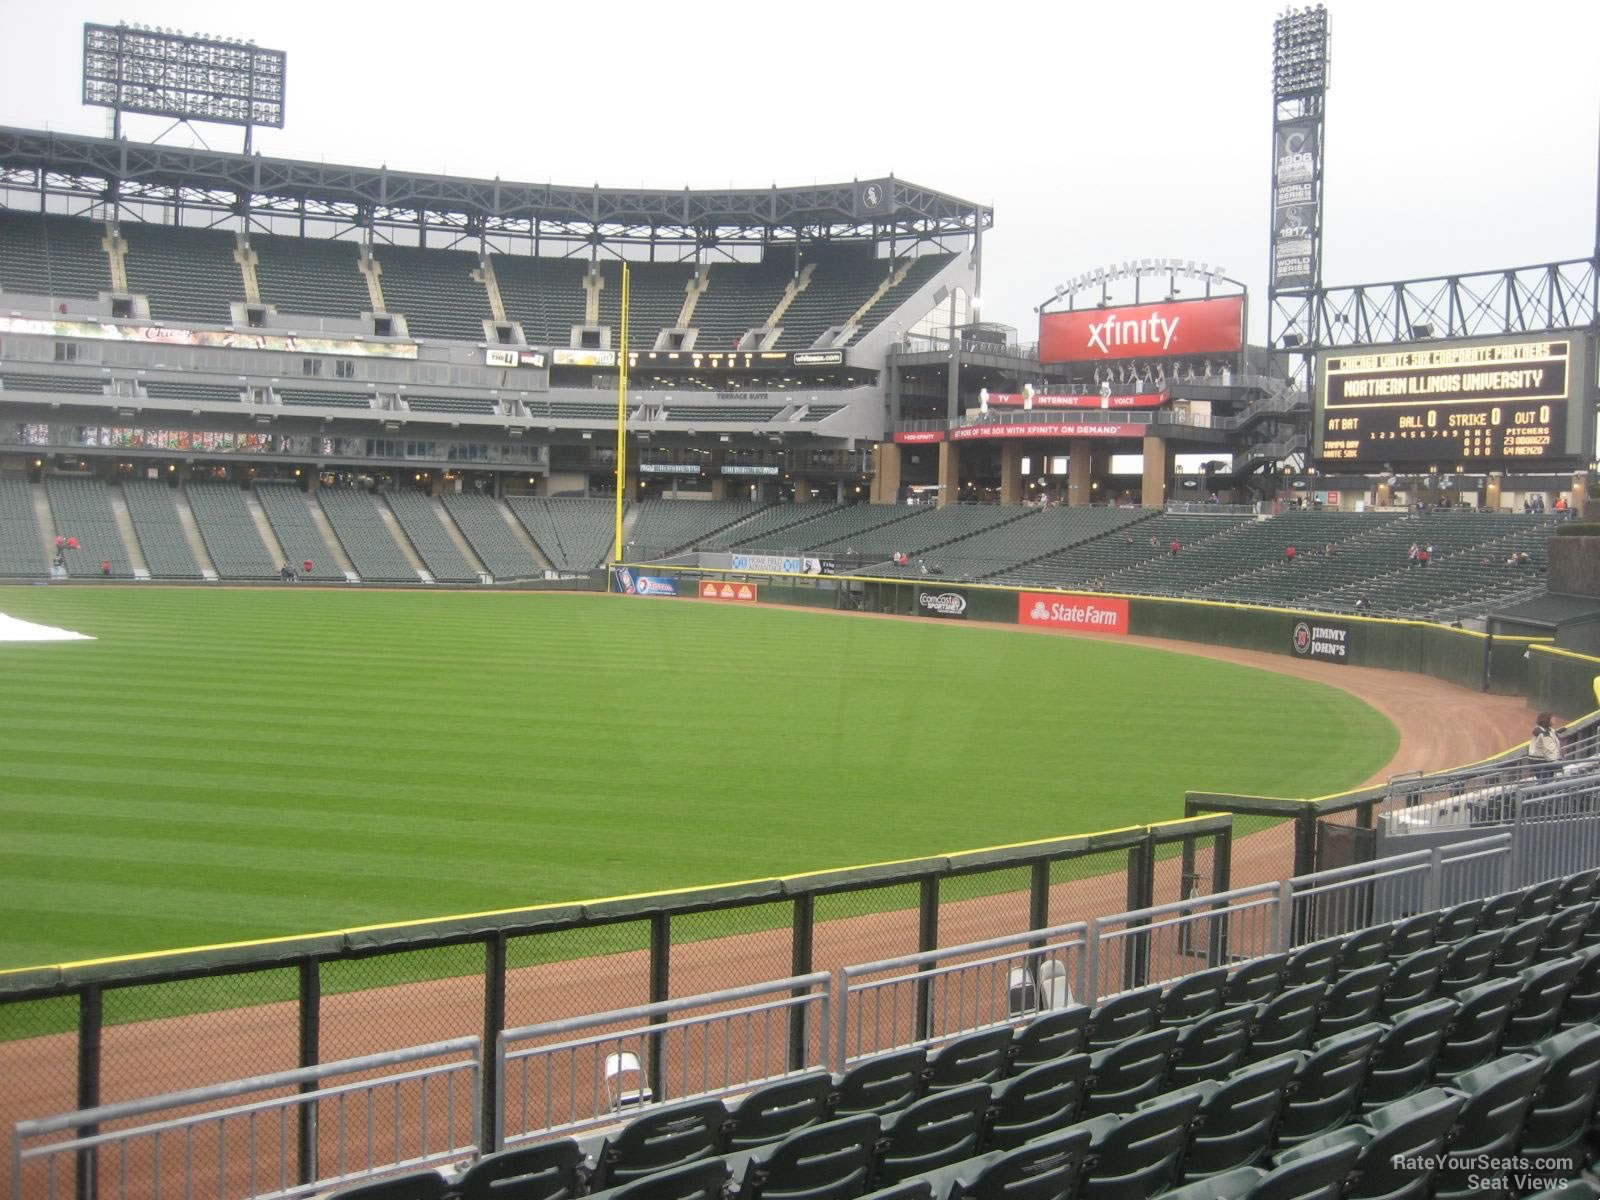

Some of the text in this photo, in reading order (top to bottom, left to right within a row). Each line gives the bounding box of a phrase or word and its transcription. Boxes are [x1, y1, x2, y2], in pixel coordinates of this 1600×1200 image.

[1279, 184, 1312, 194] WORLD
[1279, 190, 1312, 200] SERIES
[1280, 226, 1308, 237] 1917
[1278, 258, 1310, 266] WORLD
[1277, 264, 1310, 272] SERIES
[1055, 259, 1226, 302] FUNDAMENTALS
[1088, 312, 1180, 353] xfinity
[795, 354, 840, 362] whitesox.com
[1340, 344, 1550, 369] CHICAGO WHITE SOX CORPORATE PARTNERS
[1344, 369, 1543, 397] NORTHERN ILLINOIS UNIVERSITY
[1038, 397, 1079, 405] INTERNET
[1400, 410, 1436, 428] BALL 0
[1448, 408, 1500, 426] STRIKE 0
[1514, 406, 1550, 424] OUT 0
[1328, 418, 1360, 430] AT BAT
[1027, 426, 1058, 434] XFINITY
[1506, 428, 1549, 436] PITCHERS
[1324, 441, 1344, 449] TAMPA
[1346, 440, 1360, 448] BAY
[1504, 436, 1514, 445] 23
[1324, 450, 1342, 458] WHITE
[1344, 450, 1357, 458] SOX
[1050, 603, 1117, 625] State Farm
[1312, 627, 1346, 641] JIMMY
[1311, 641, 1345, 656] JOHN'S
